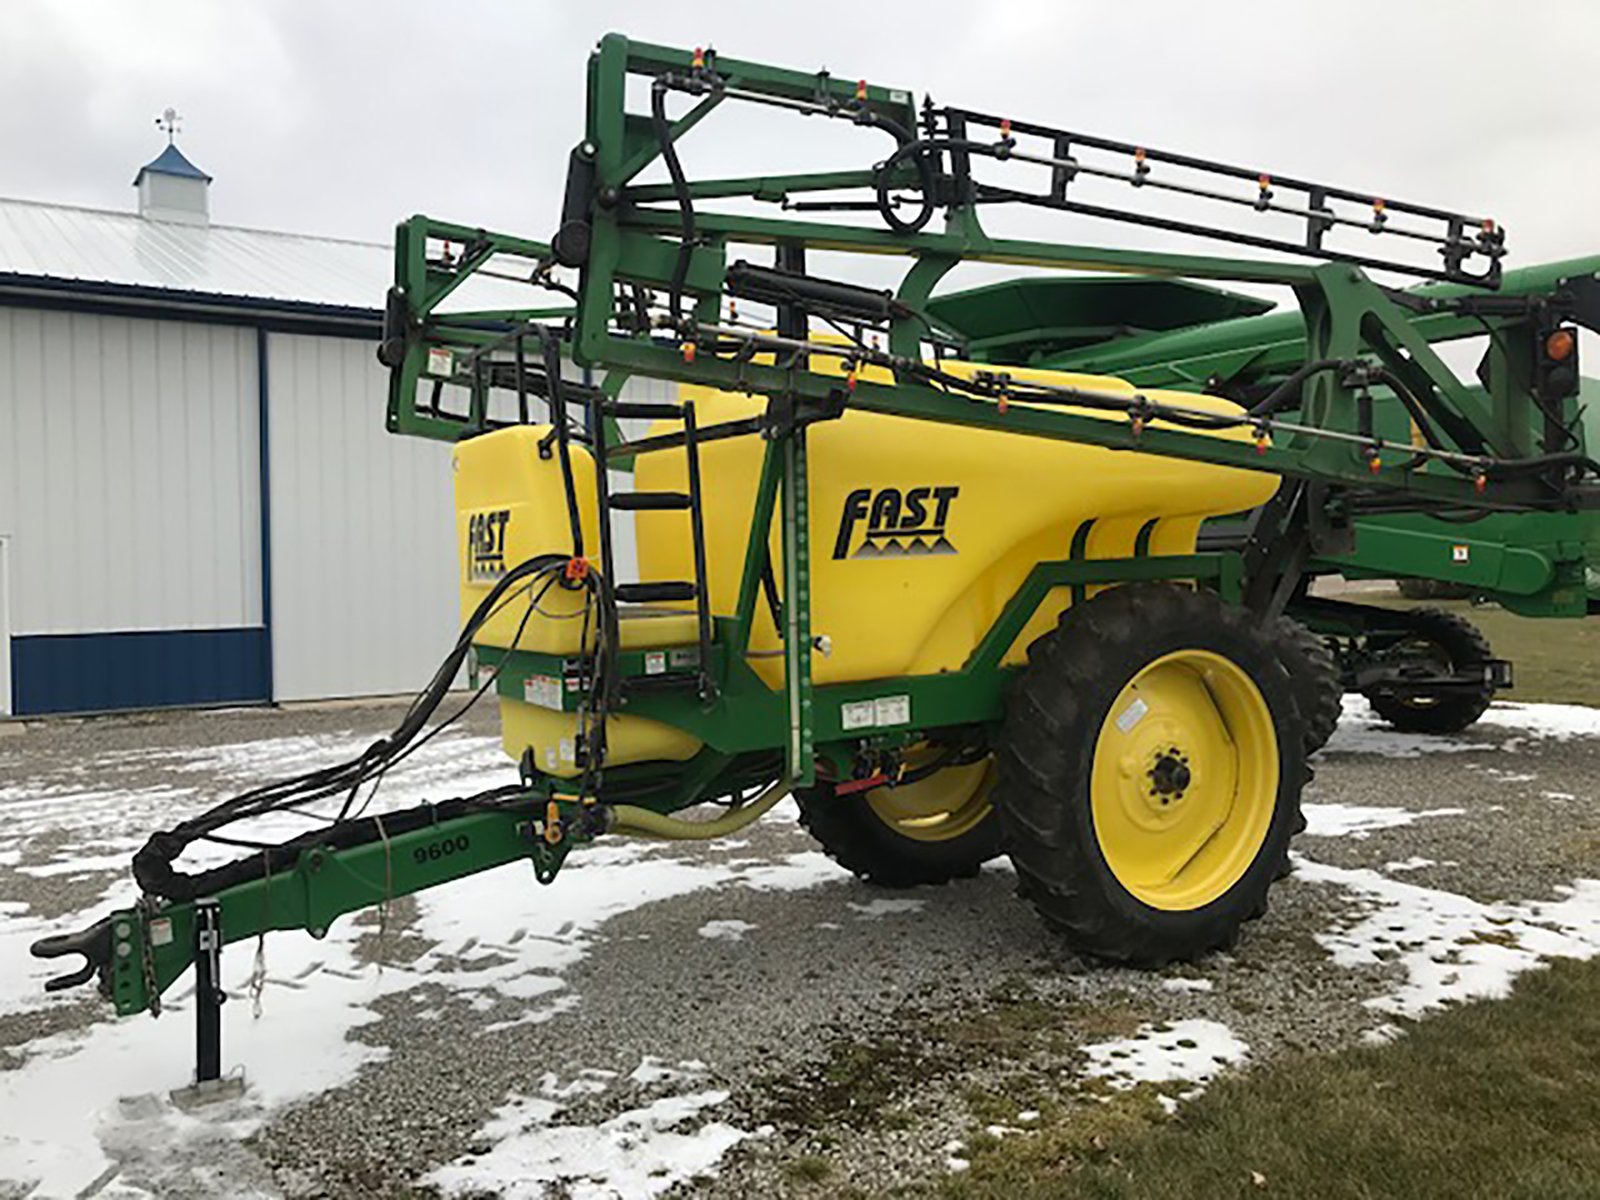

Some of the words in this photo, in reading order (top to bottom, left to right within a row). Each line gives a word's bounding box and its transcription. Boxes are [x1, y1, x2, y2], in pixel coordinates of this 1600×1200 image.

[468, 510, 510, 582] FAST
[832, 486, 960, 560] FAST
[413, 834, 470, 865] 9600
